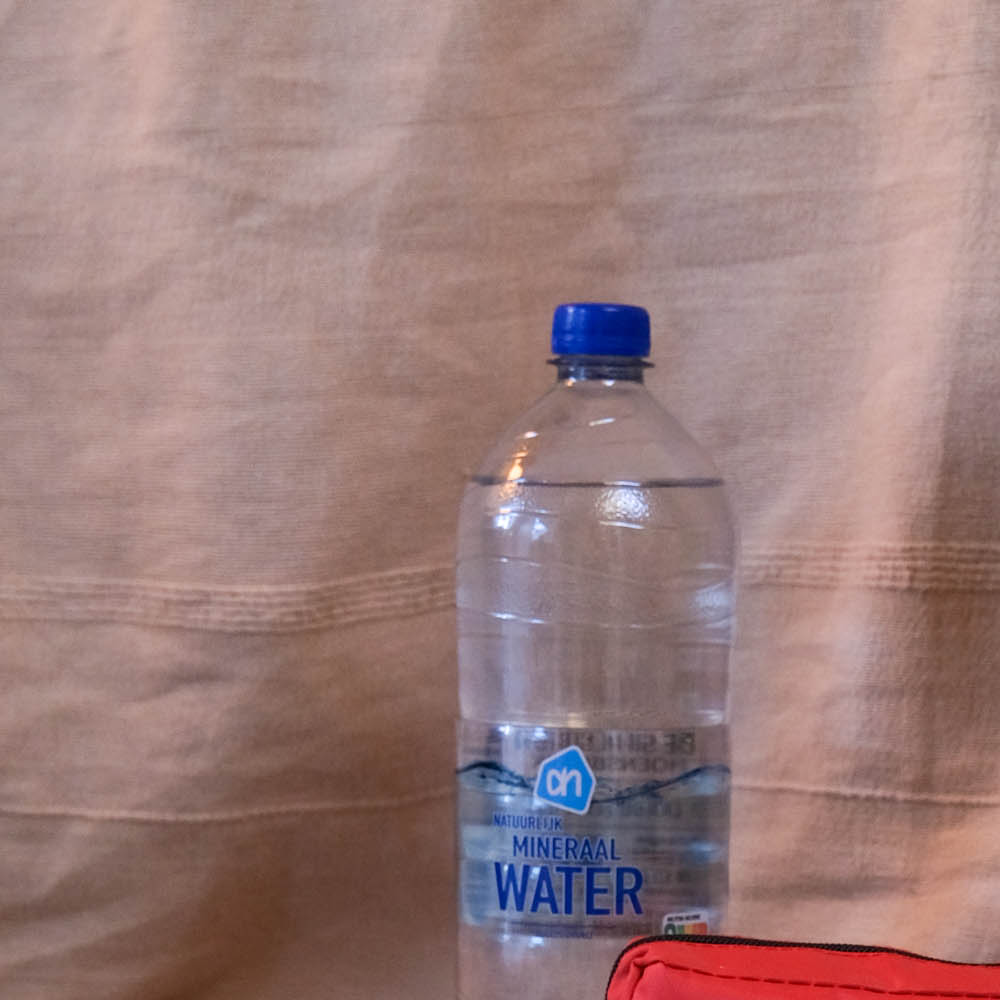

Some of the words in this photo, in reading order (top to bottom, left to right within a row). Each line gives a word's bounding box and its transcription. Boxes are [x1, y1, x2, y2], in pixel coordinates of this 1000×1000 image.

[494, 814, 563, 831] NATUURLIJK
[512, 835, 622, 861] MINERAAL
[494, 861, 644, 916] WATER
